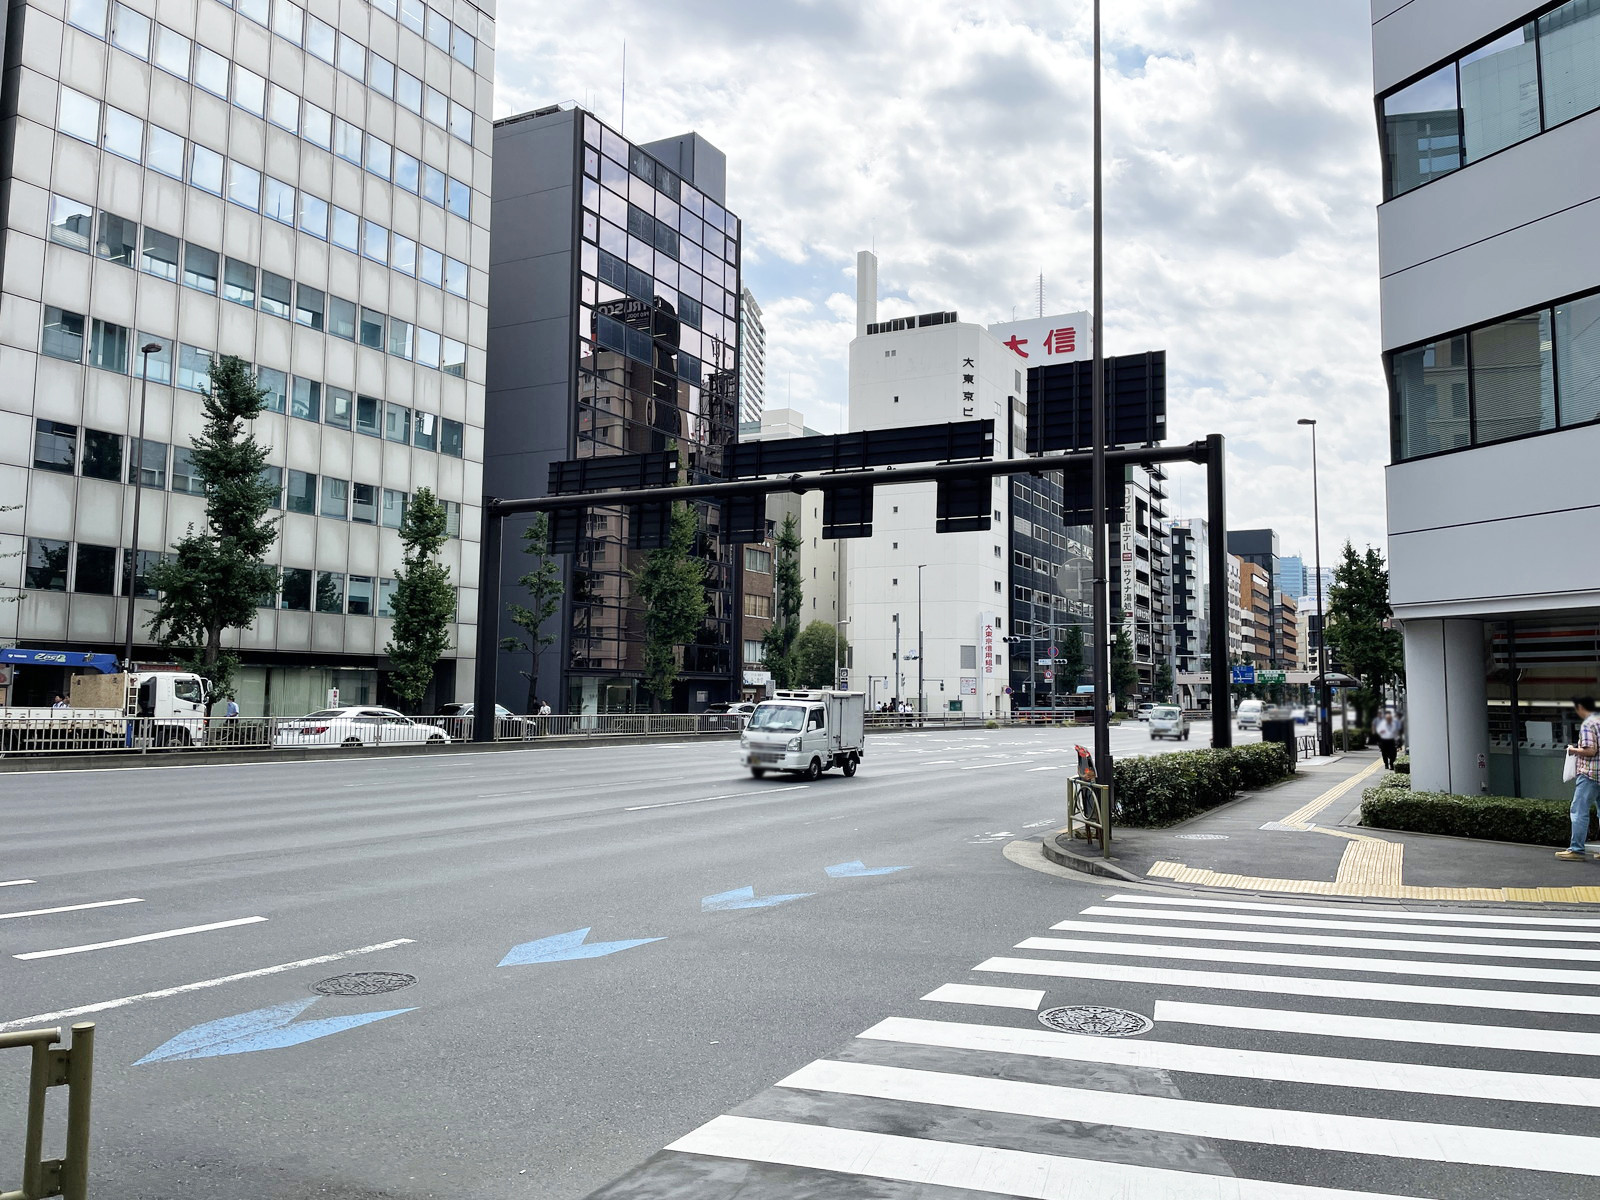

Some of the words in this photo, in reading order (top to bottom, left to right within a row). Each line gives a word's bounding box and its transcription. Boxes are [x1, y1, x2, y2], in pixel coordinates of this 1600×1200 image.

[1002, 326, 1077, 359] 大信
[963, 357, 974, 416] 大東京ビ
